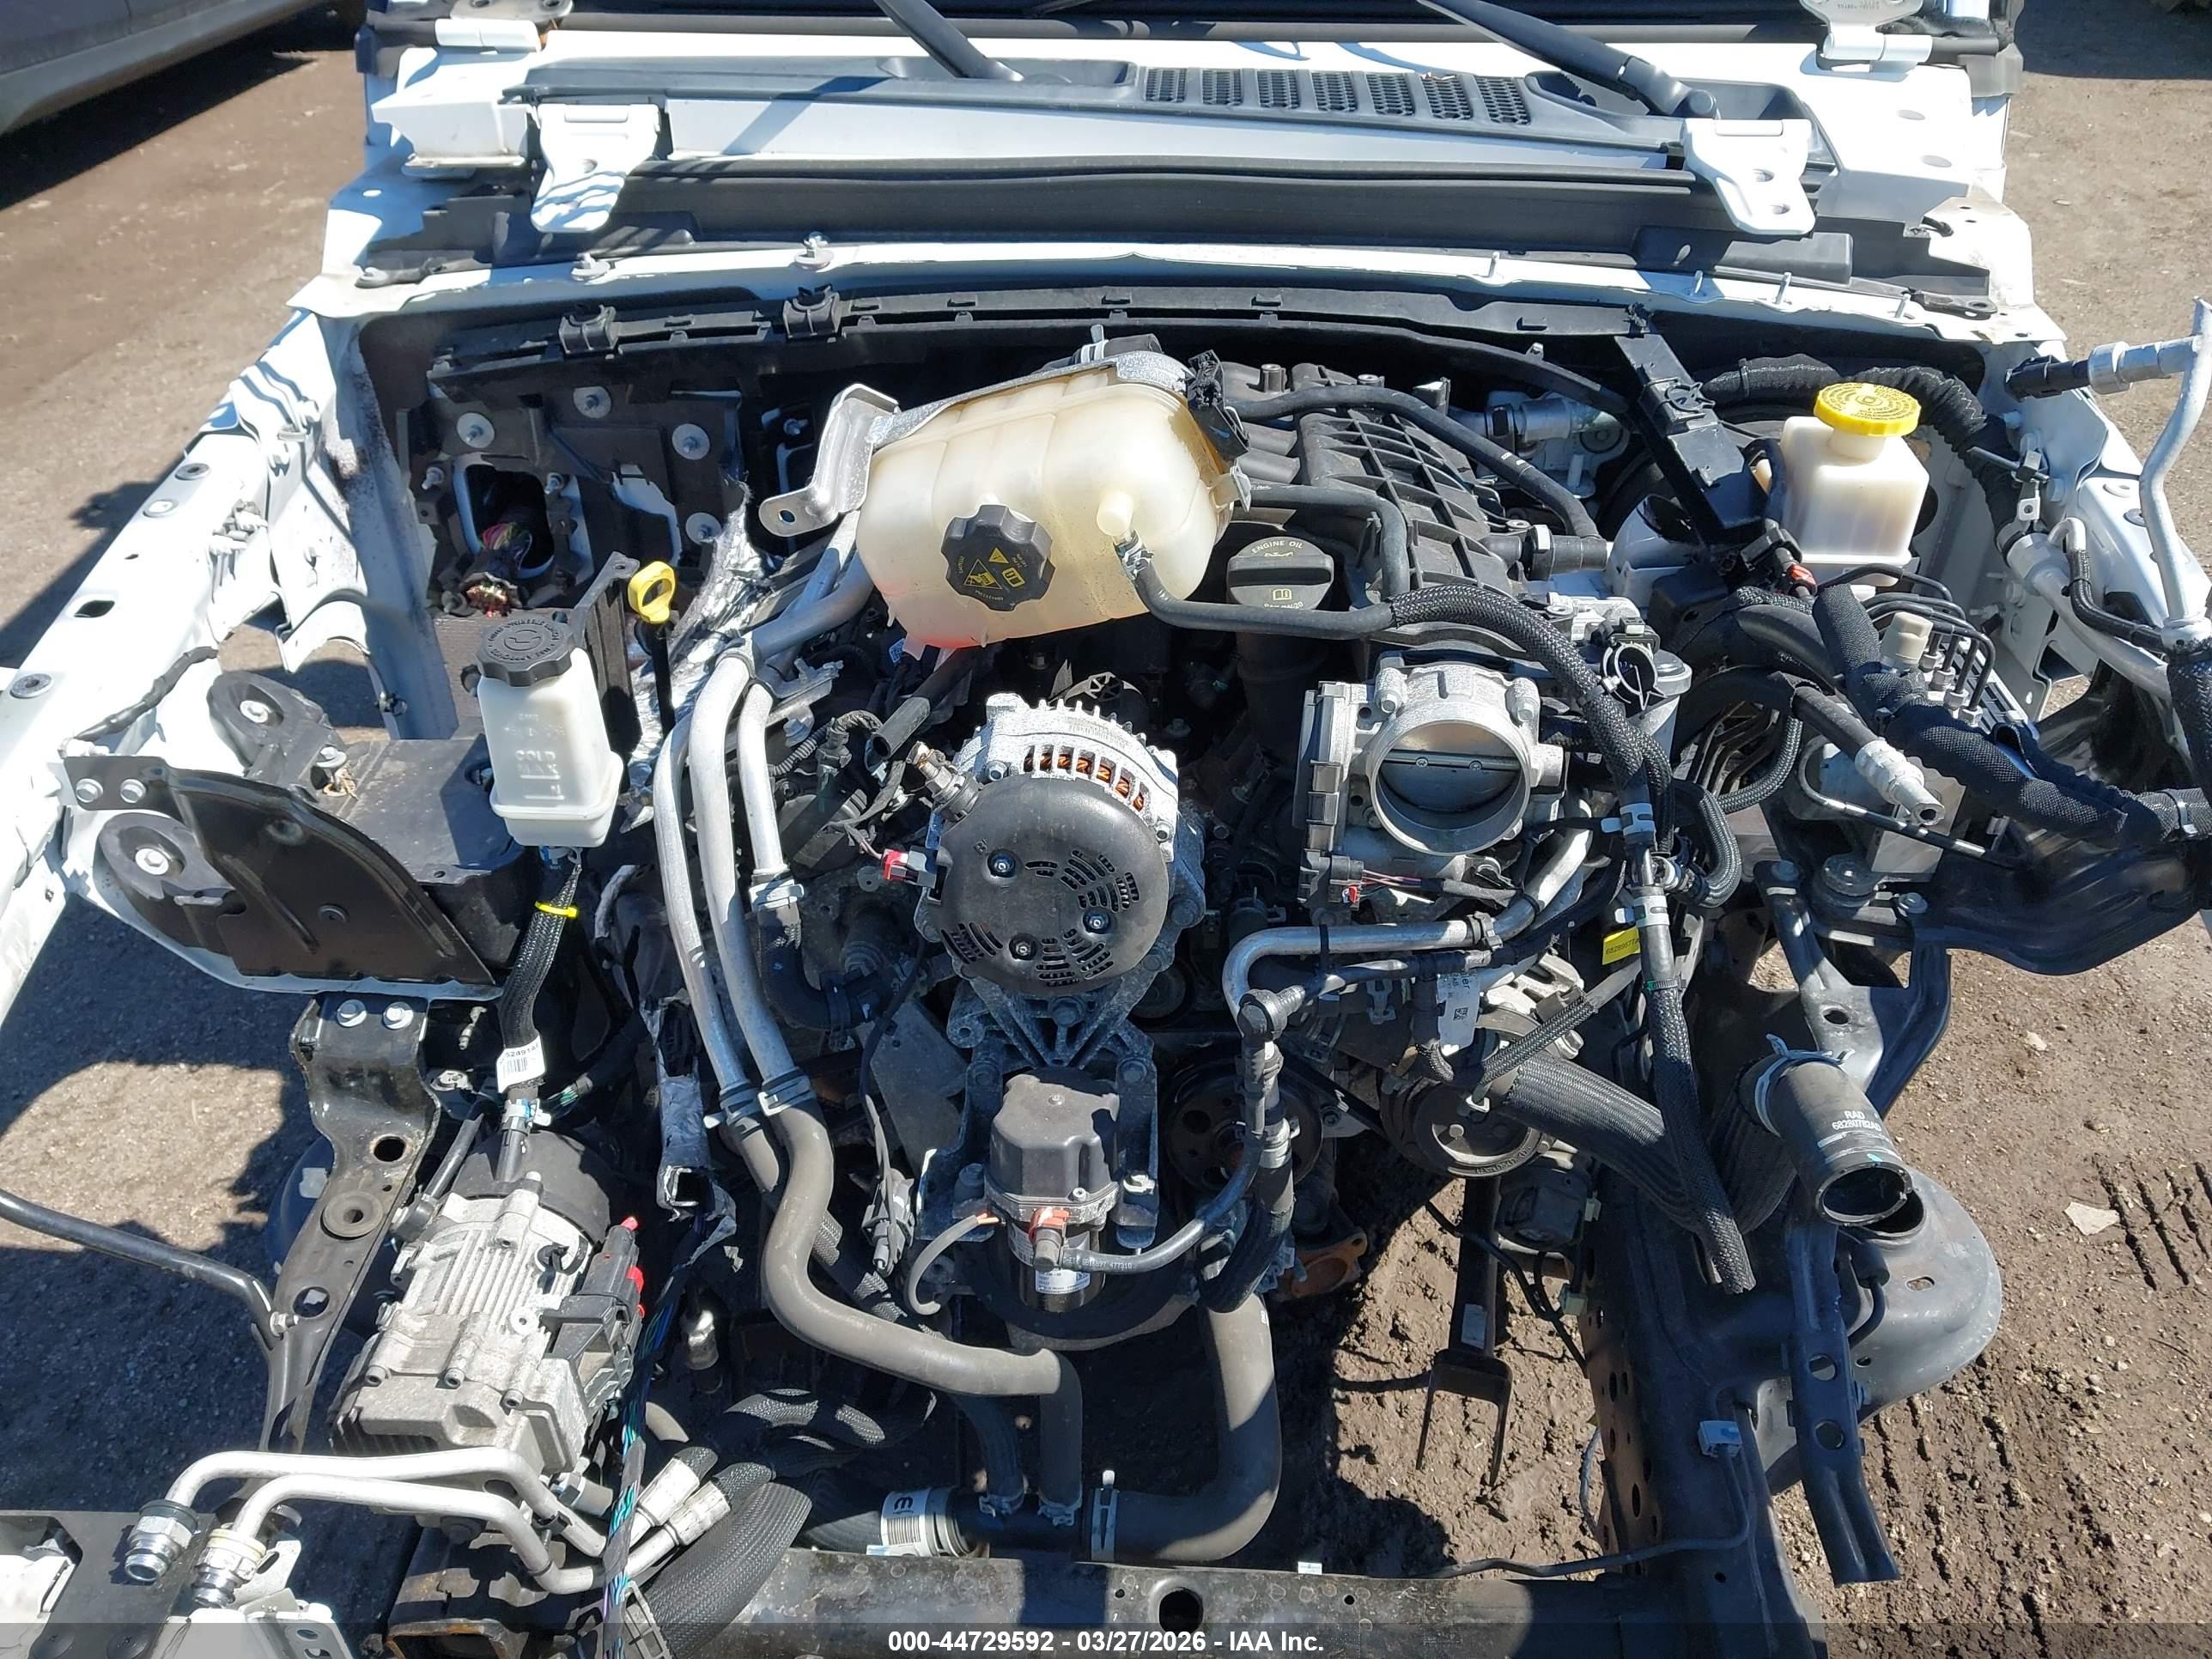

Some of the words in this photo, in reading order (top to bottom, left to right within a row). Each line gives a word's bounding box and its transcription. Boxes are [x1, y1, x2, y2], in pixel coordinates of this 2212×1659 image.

[1250, 540, 1286, 554] ENGINE
[1288, 540, 1304, 550] OIL
[515, 750, 556, 762] COLD
[1844, 1110, 1866, 1120] RAD
